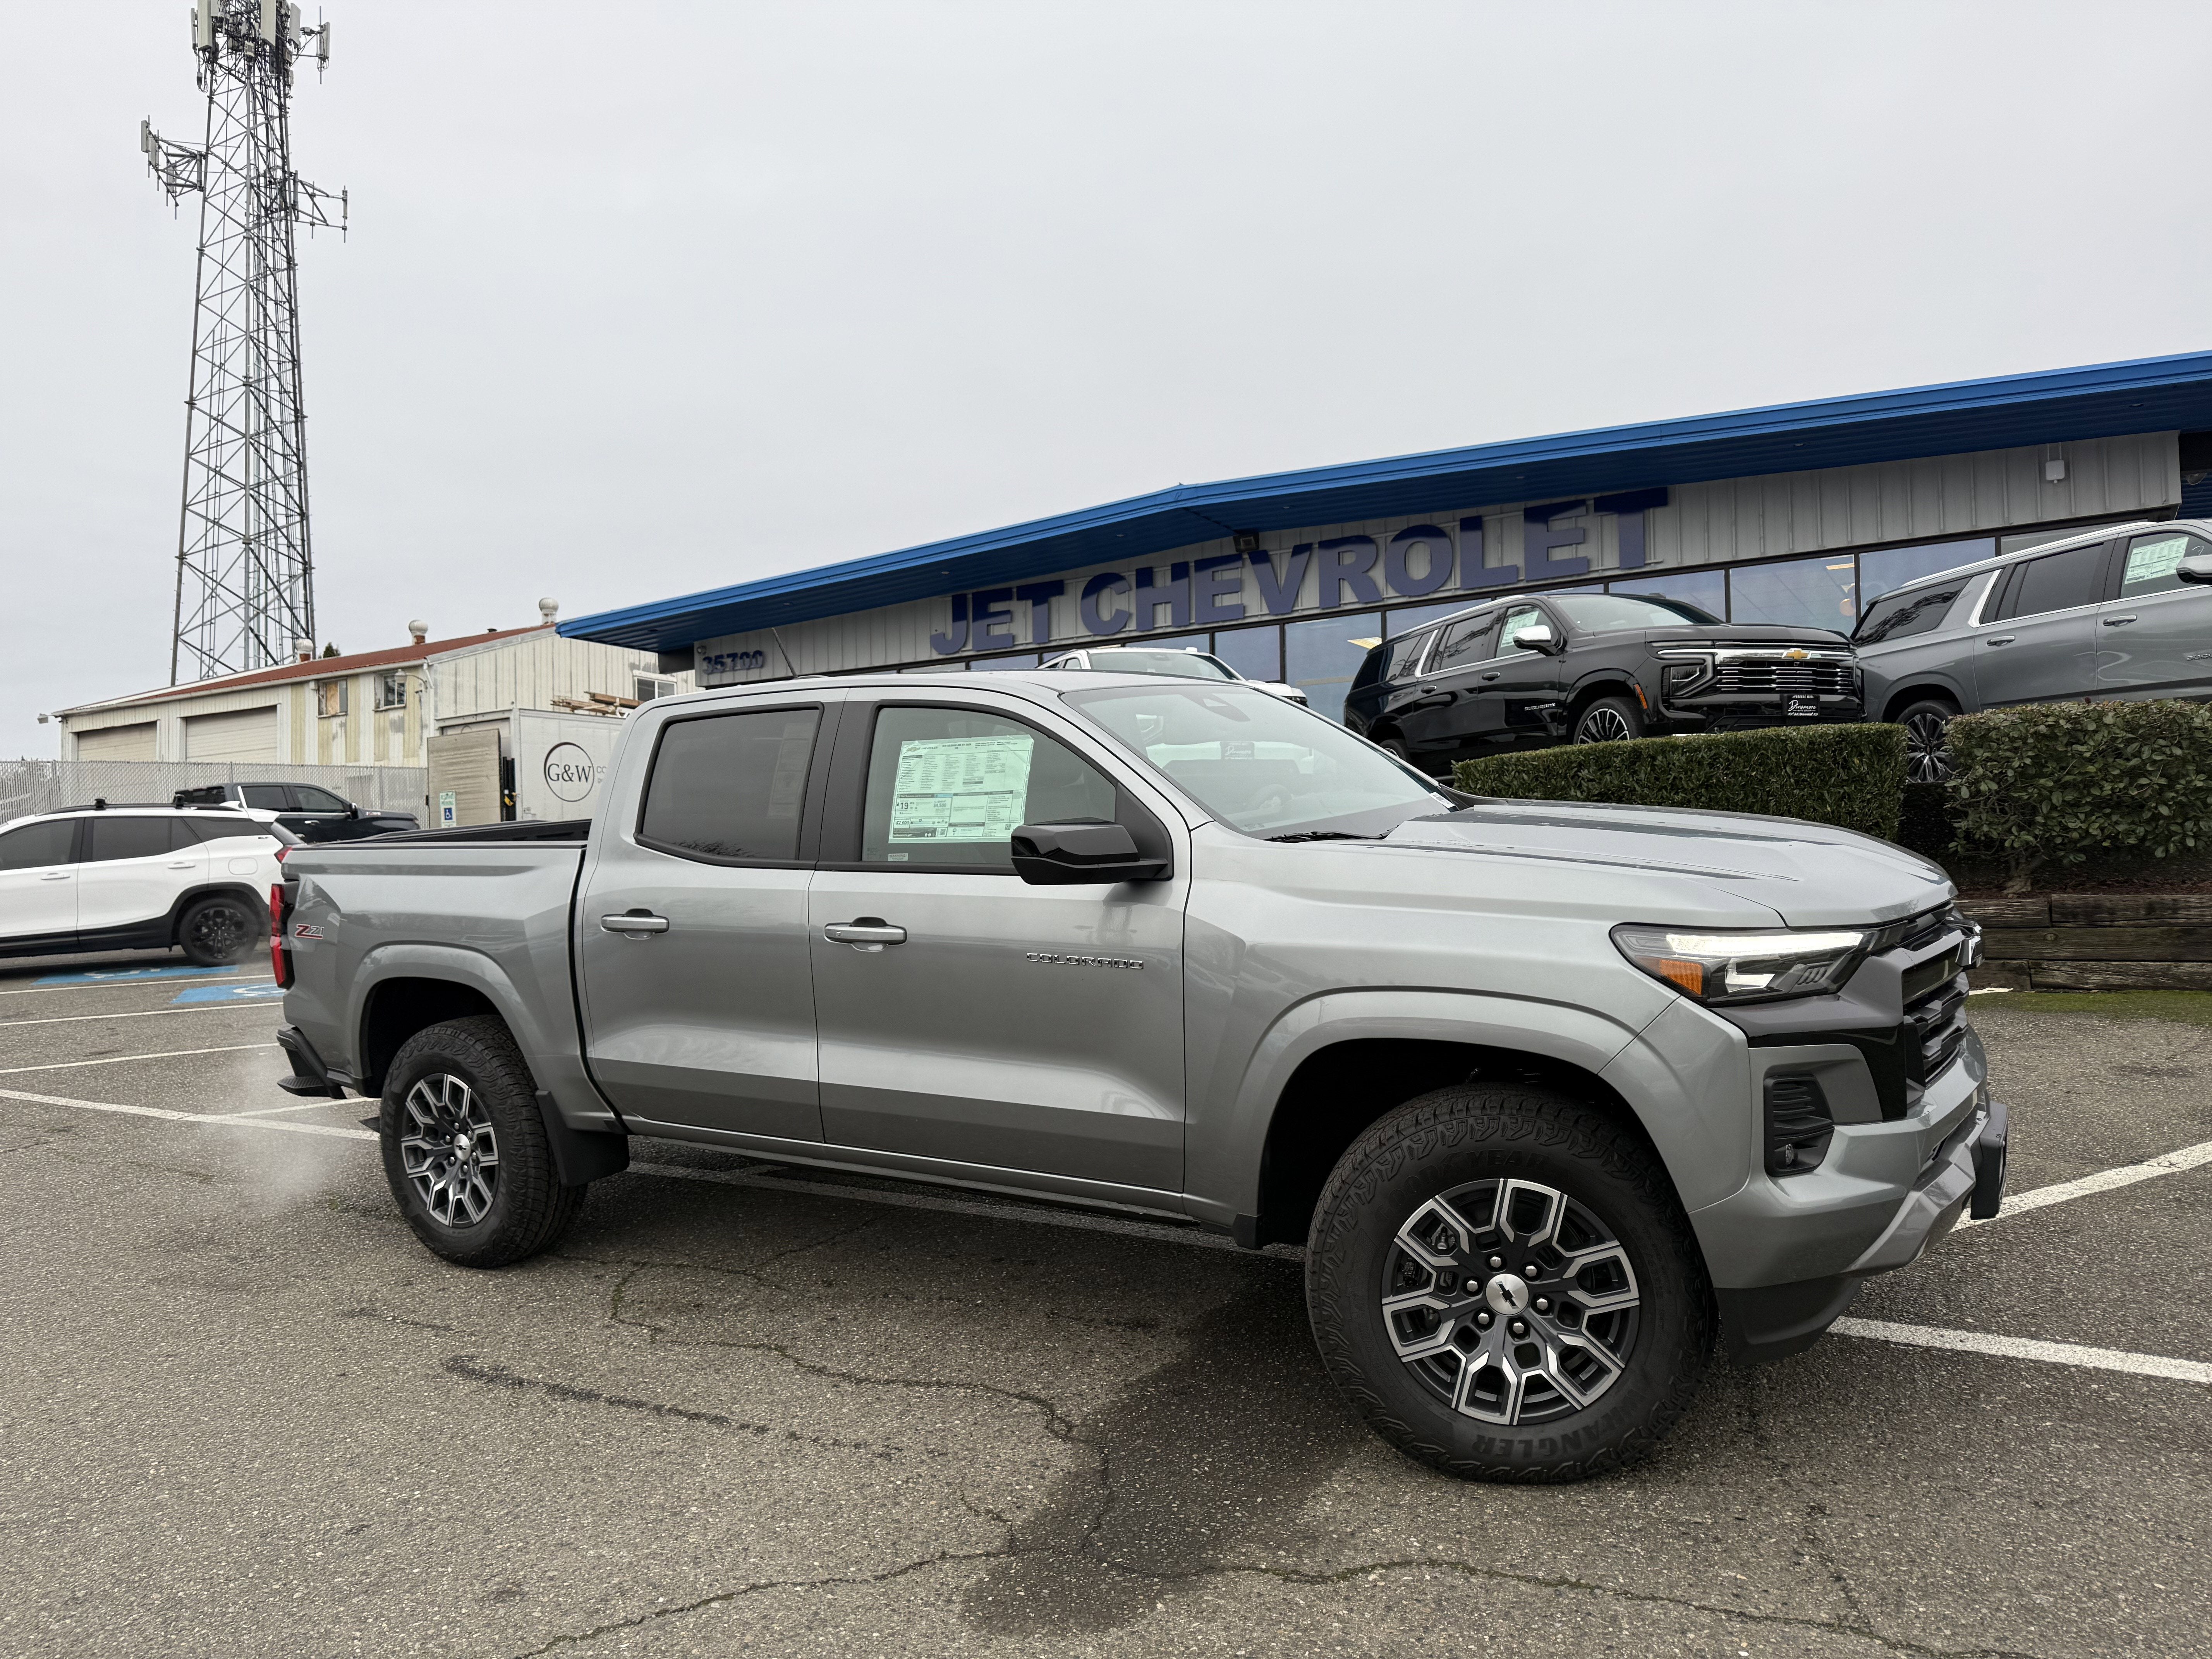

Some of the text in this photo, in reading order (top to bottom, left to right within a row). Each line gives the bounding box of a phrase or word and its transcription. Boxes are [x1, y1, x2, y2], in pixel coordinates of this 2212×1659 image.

[930, 486, 1668, 655] JET CHEVROLET
[702, 650, 763, 675] 35700
[547, 763, 592, 783] G&W
[295, 924, 325, 940] Z71
[1027, 953, 1144, 969] COLORADO
